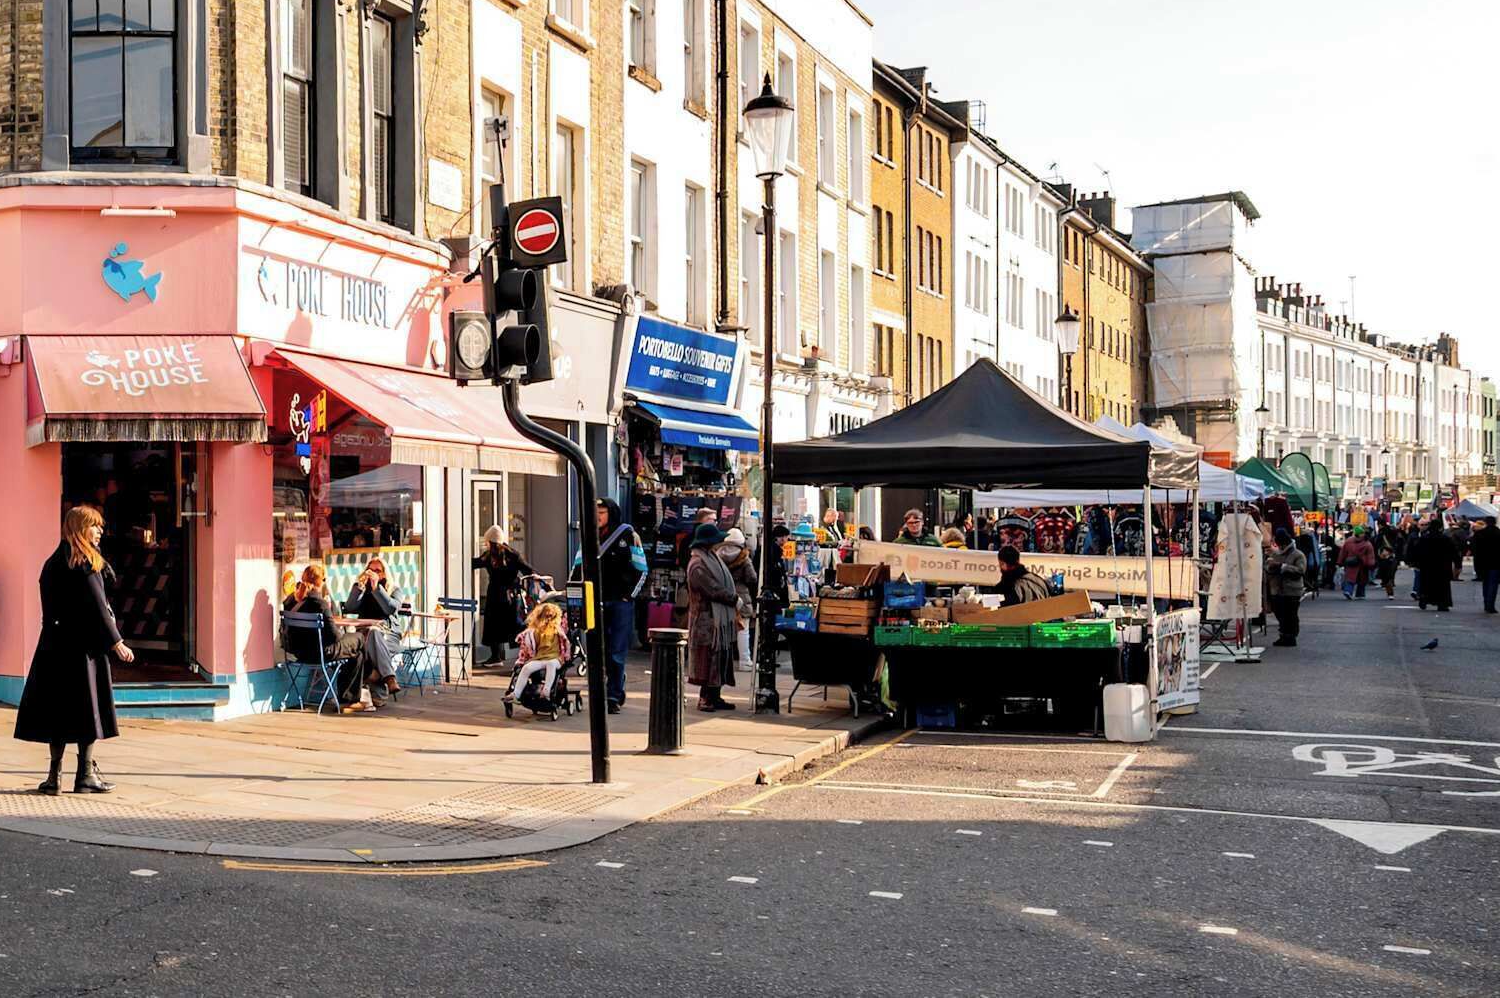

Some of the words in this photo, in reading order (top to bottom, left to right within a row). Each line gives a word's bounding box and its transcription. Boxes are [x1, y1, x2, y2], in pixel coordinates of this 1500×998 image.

[124, 343, 201, 369] POKE
[638, 335, 685, 363] PORTOBELLO
[684, 346, 717, 371] SOUVENIR
[715, 354, 734, 374] GIFTS
[81, 364, 209, 397] HOUSE
